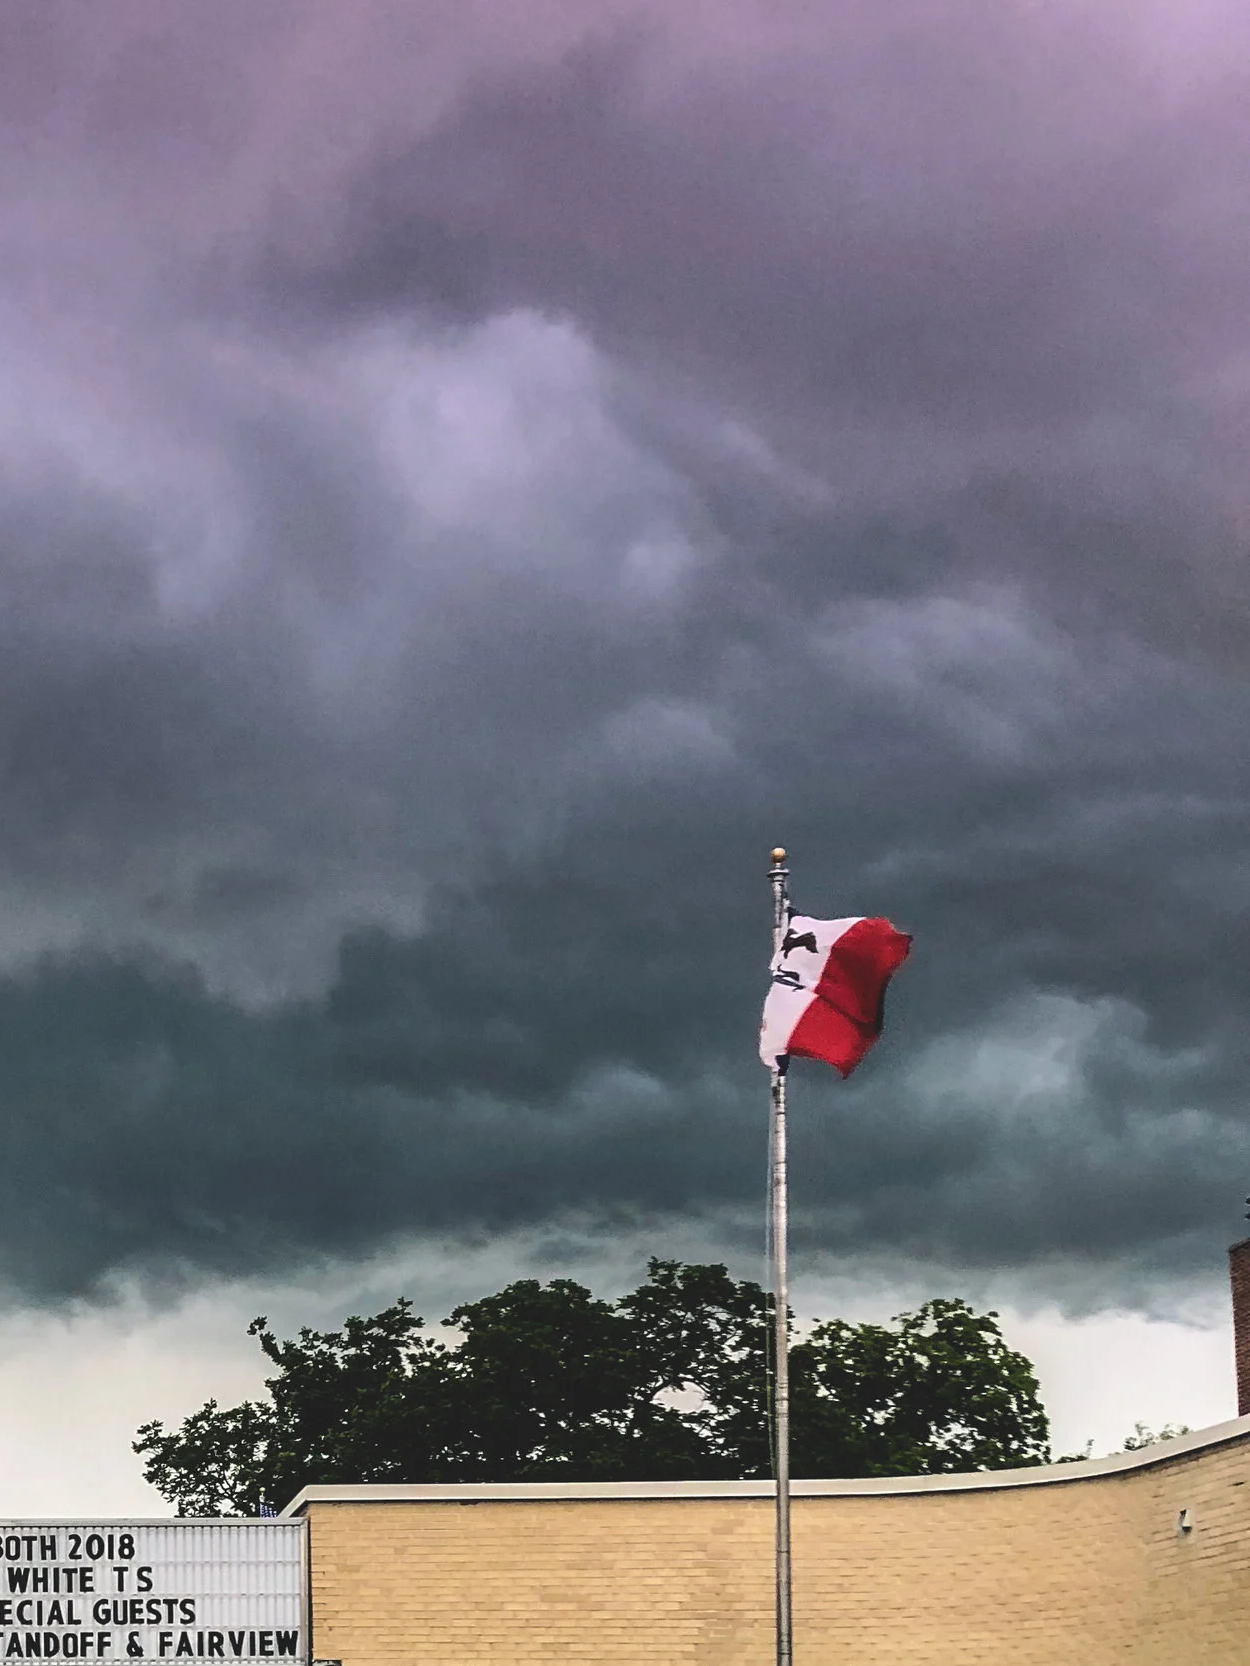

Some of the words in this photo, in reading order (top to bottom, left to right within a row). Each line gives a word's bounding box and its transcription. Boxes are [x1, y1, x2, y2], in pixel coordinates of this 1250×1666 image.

[68, 1533, 135, 1561] 2018
[7, 1566, 95, 1594] WHITE
[92, 1598, 196, 1626] GUESTS
[126, 1631, 144, 1658] &
[159, 1630, 299, 1658] FAIRVIEW
